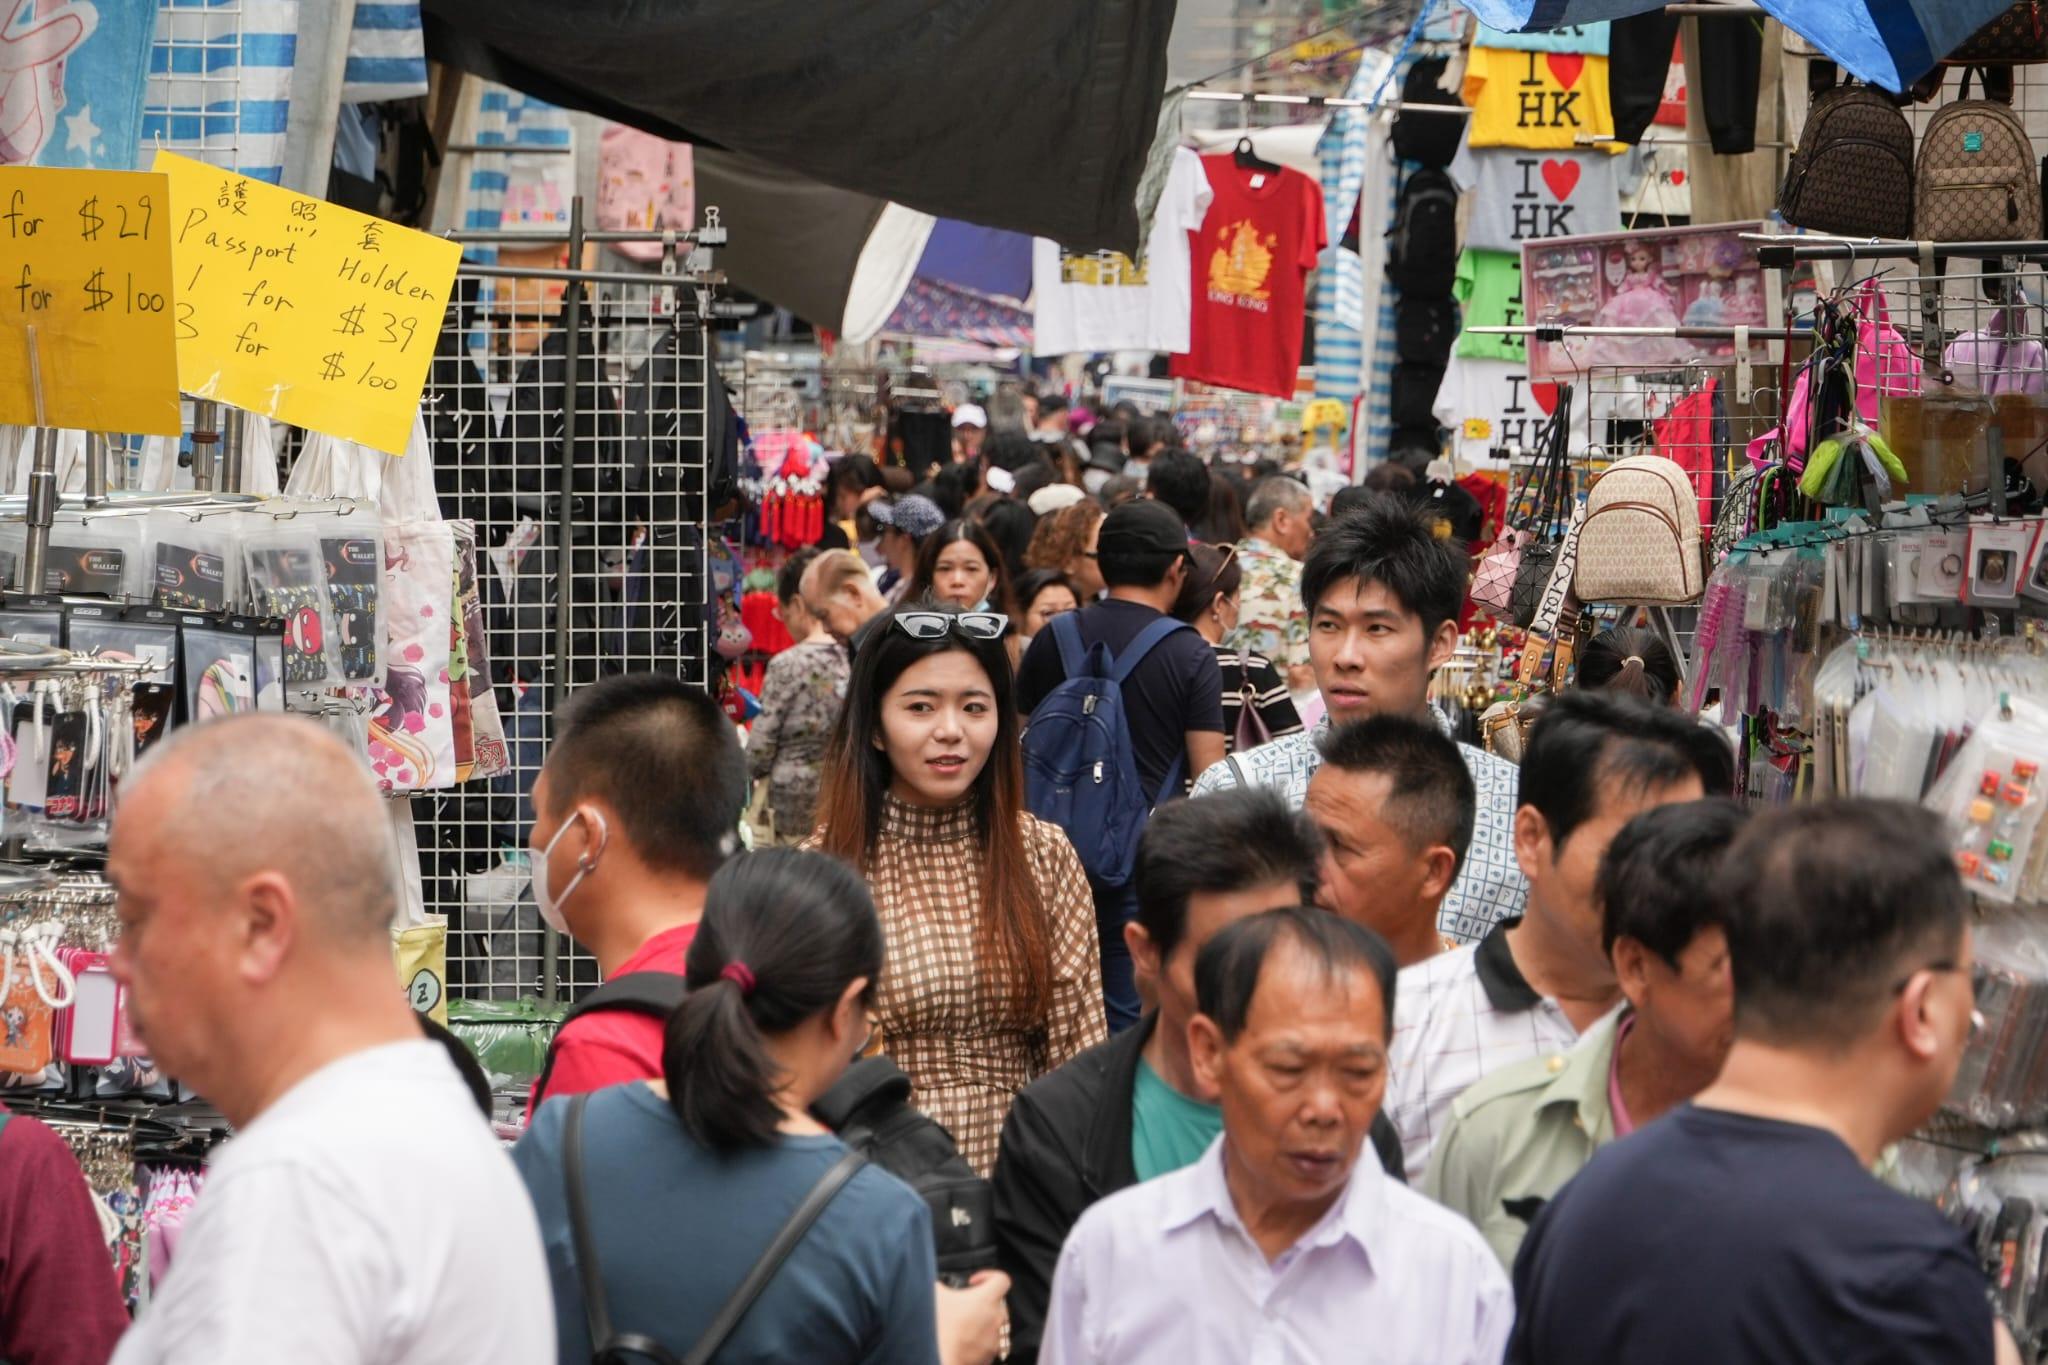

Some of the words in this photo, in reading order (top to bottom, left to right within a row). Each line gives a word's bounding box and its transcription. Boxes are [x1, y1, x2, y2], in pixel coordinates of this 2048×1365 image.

[1520, 51, 1543, 86] I
[1517, 91, 1581, 127] HK
[1515, 159, 1538, 198] I
[3, 189, 44, 238] for
[1511, 204, 1574, 239] HK
[179, 207, 297, 271] Passport
[338, 257, 435, 302] Holder
[14, 263, 52, 313] for
[187, 264, 203, 292] 1
[243, 280, 294, 312] for
[175, 302, 199, 340] 3
[236, 322, 269, 356] for
[1504, 376, 1527, 413] I
[92, 563, 120, 572] WALLET
[201, 567, 223, 578] WALLET
